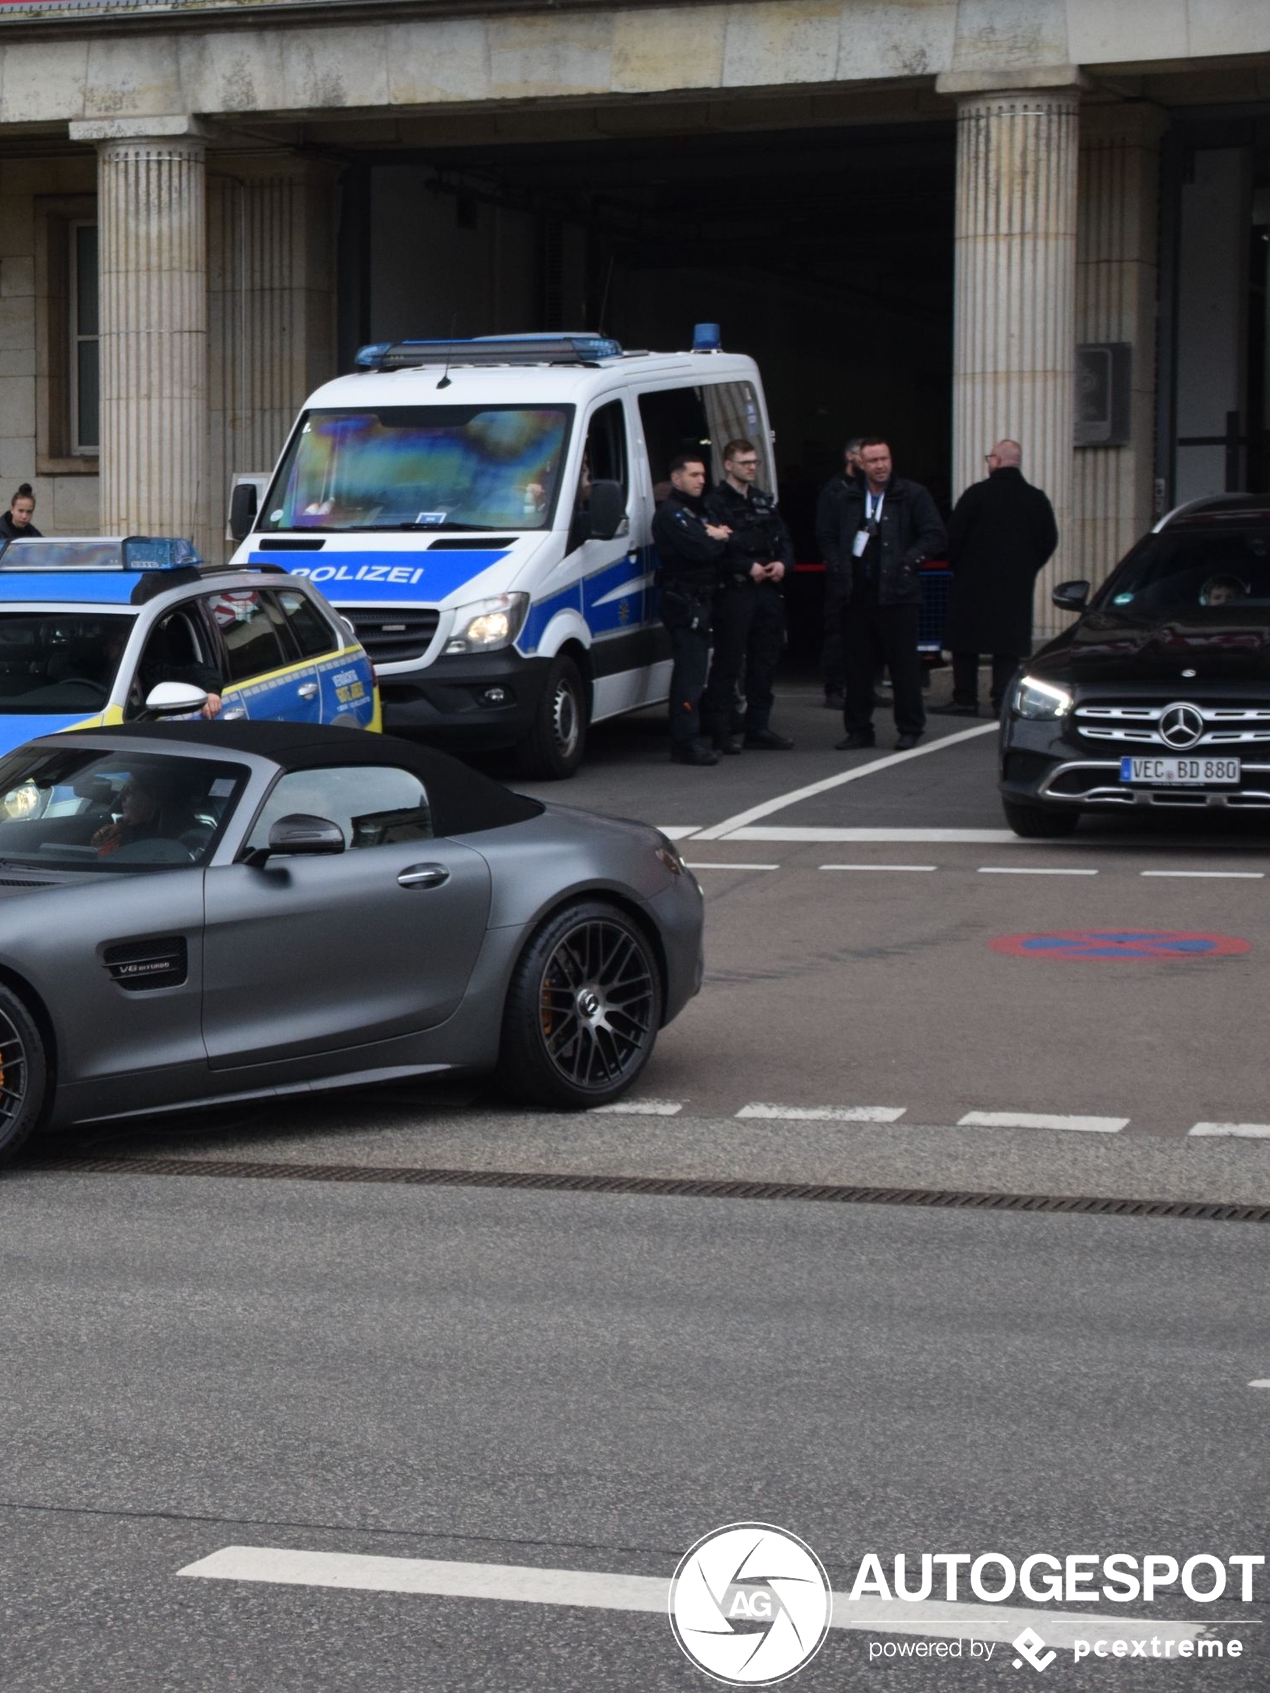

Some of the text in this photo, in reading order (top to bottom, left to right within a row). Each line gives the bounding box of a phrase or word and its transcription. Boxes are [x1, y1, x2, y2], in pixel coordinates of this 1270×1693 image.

[289, 565, 424, 584] POLIZEI
[1133, 760, 1237, 779] VEC BD 880
